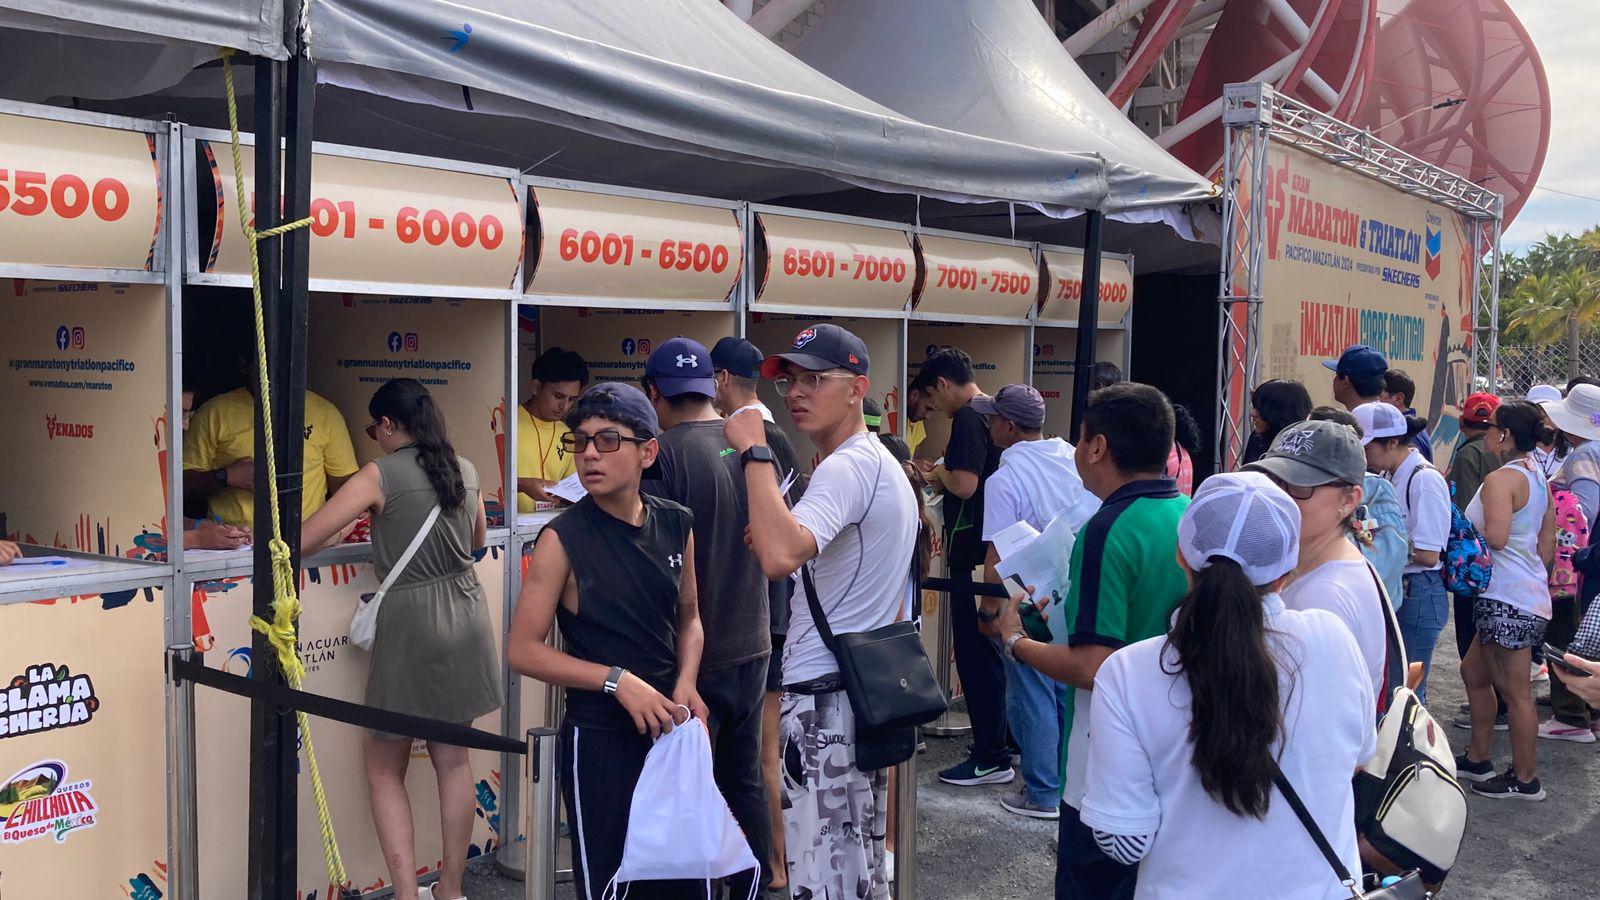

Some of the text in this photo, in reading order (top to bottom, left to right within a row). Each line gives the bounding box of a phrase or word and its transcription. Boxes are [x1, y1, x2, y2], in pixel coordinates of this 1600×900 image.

[0, 169, 130, 222] 500
[368, 217, 385, 230] -
[396, 206, 504, 250] 6000
[1287, 194, 1421, 264] MARATÓN & TRIATLÓN
[560, 228, 729, 274] 6001 - 6500
[784, 247, 906, 283] 6501 - 7000
[937, 264, 978, 291] 7001
[990, 270, 1031, 296] 7500
[1382, 266, 1421, 289] SKECHERS
[1389, 312, 1425, 362] CONTIGO!
[307, 635, 351, 652] ACUAR
[29, 666, 54, 684] LA
[57, 781, 90, 793] QUESOS
[4, 790, 94, 829] CHILCHOTA
[4, 832, 11, 840] El
[12, 826, 46, 841] Queso
